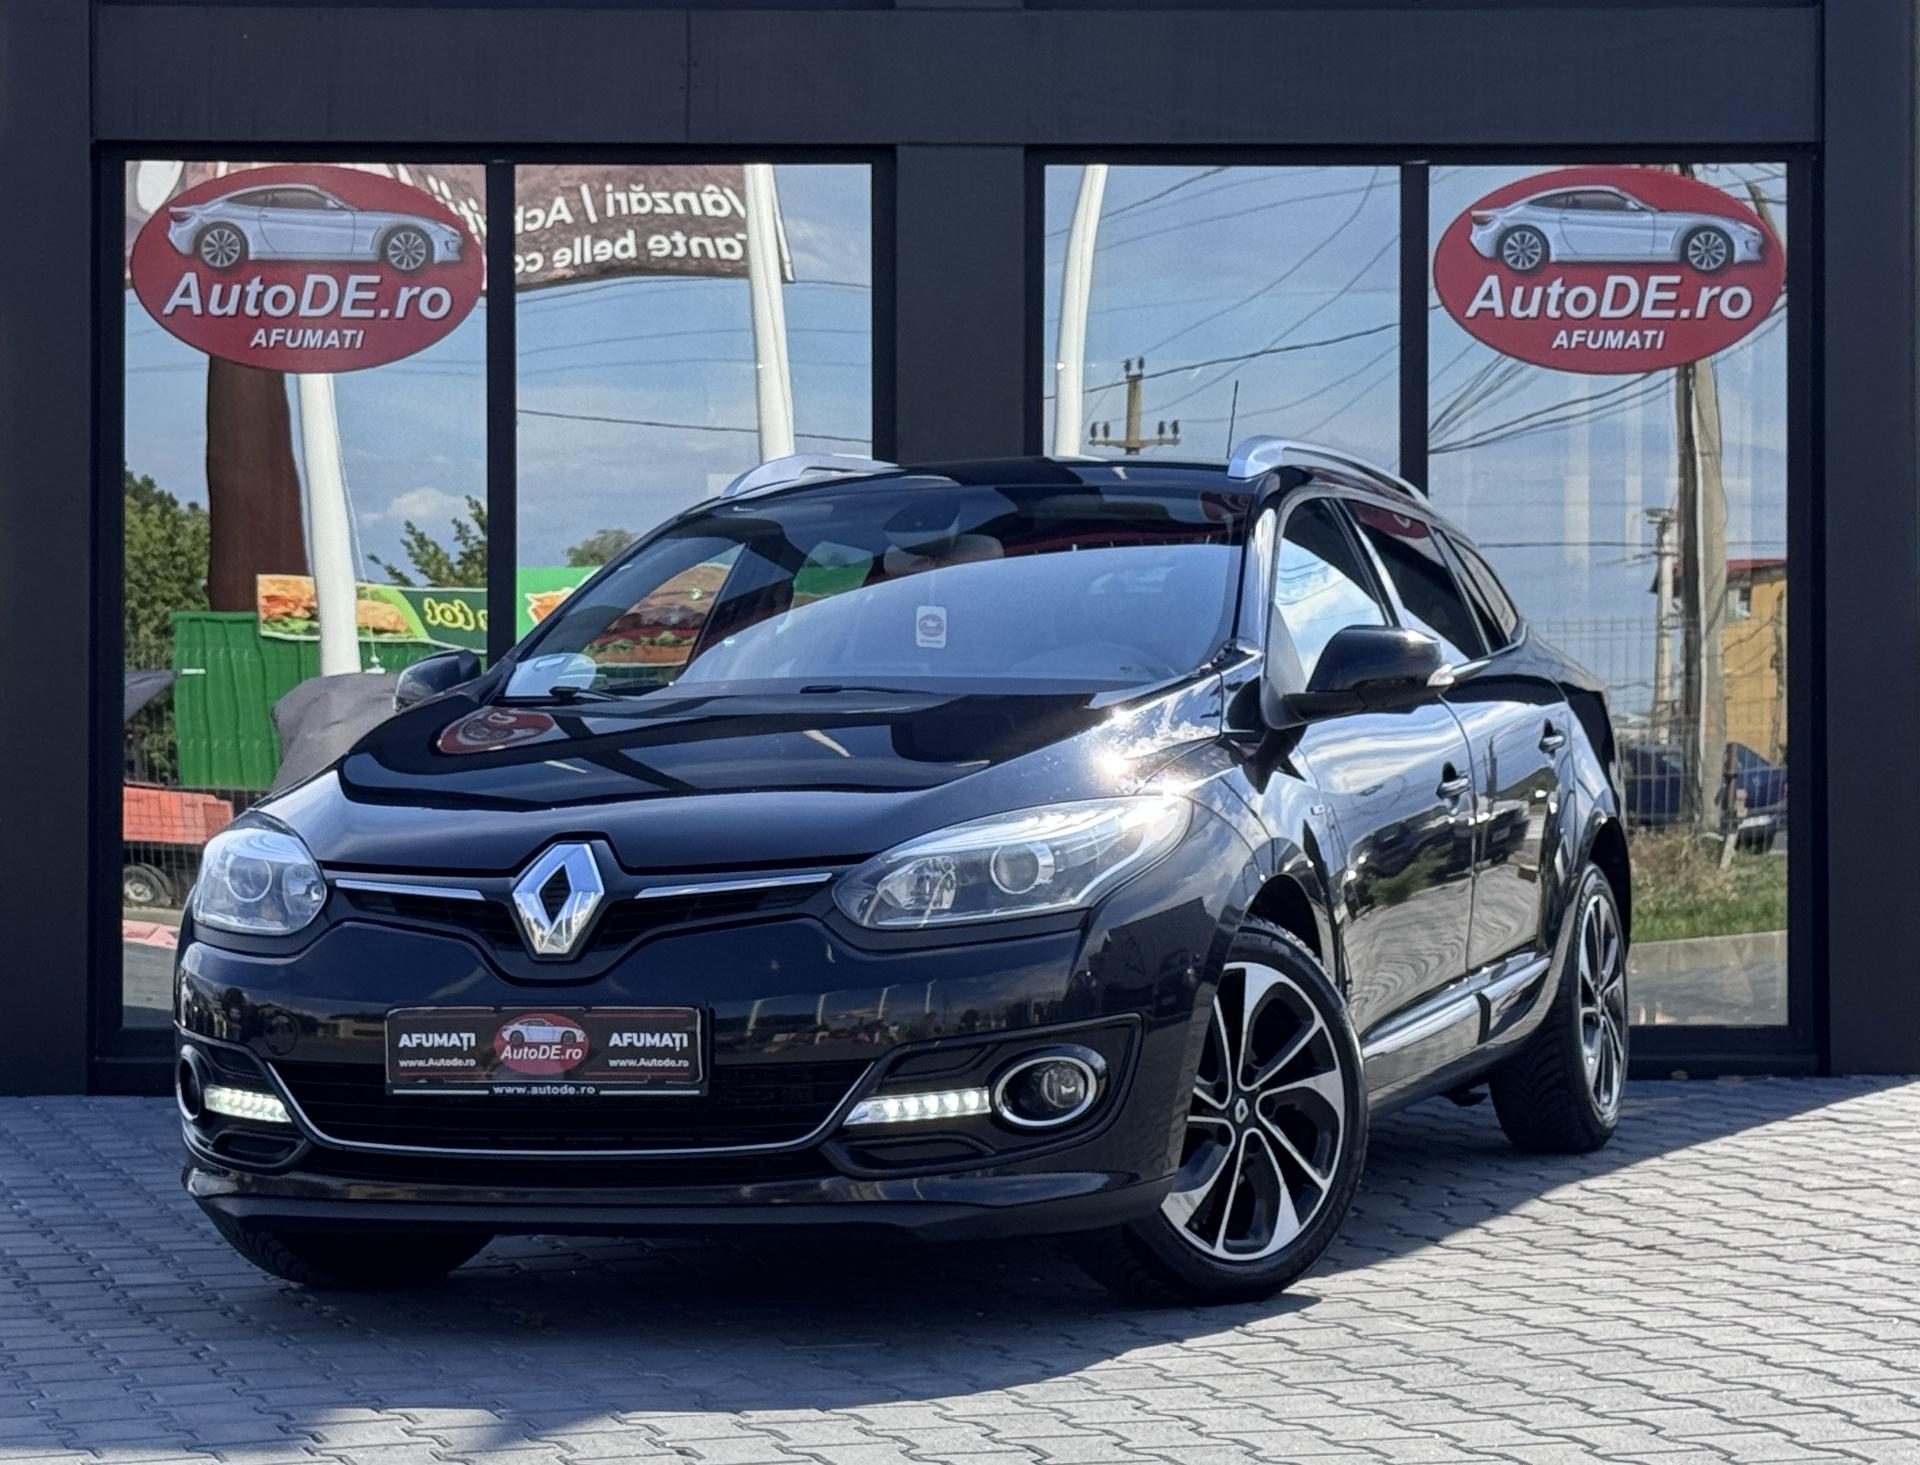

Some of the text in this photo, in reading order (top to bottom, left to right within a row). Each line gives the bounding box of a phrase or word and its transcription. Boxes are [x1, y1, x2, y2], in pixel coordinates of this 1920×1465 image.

[162, 271, 453, 321] AutoDE.ro
[1465, 274, 1753, 321] AutoDE.ro
[250, 328, 364, 349] AFUMATI
[1551, 330, 1664, 350] AFUMATI
[500, 1044, 583, 1060] AutoDE.ro
[492, 1084, 596, 1096] www.autode.ro
